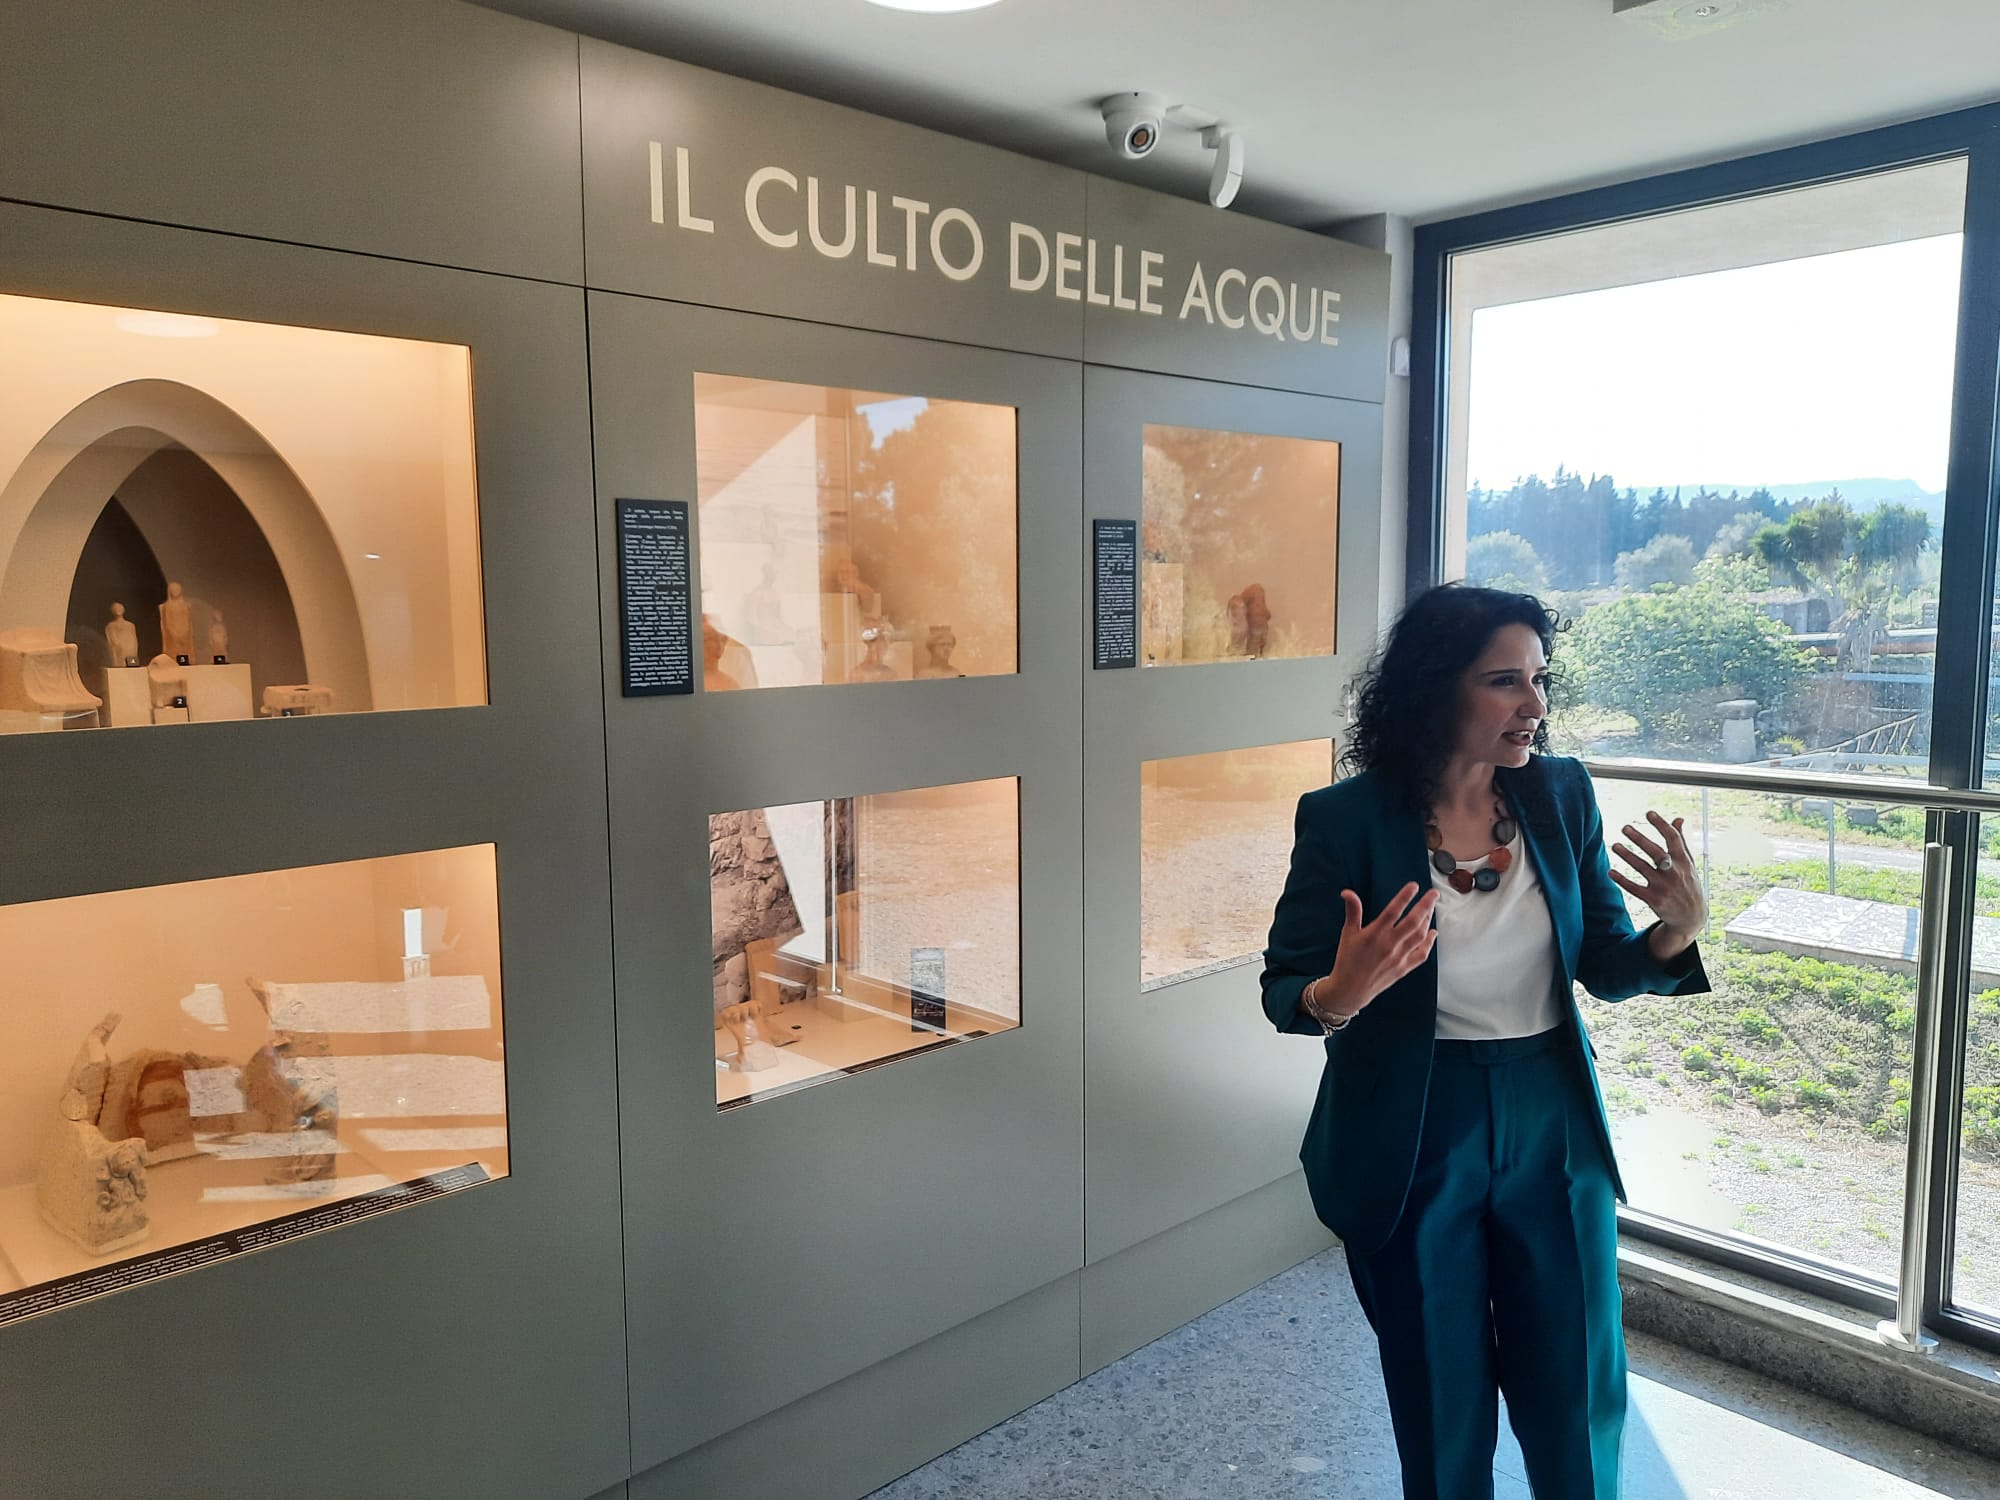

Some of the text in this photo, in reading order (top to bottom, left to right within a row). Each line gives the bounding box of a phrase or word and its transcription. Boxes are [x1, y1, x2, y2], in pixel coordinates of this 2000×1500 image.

[649, 140, 1342, 347] IL CULTO DELLE ACQUE
